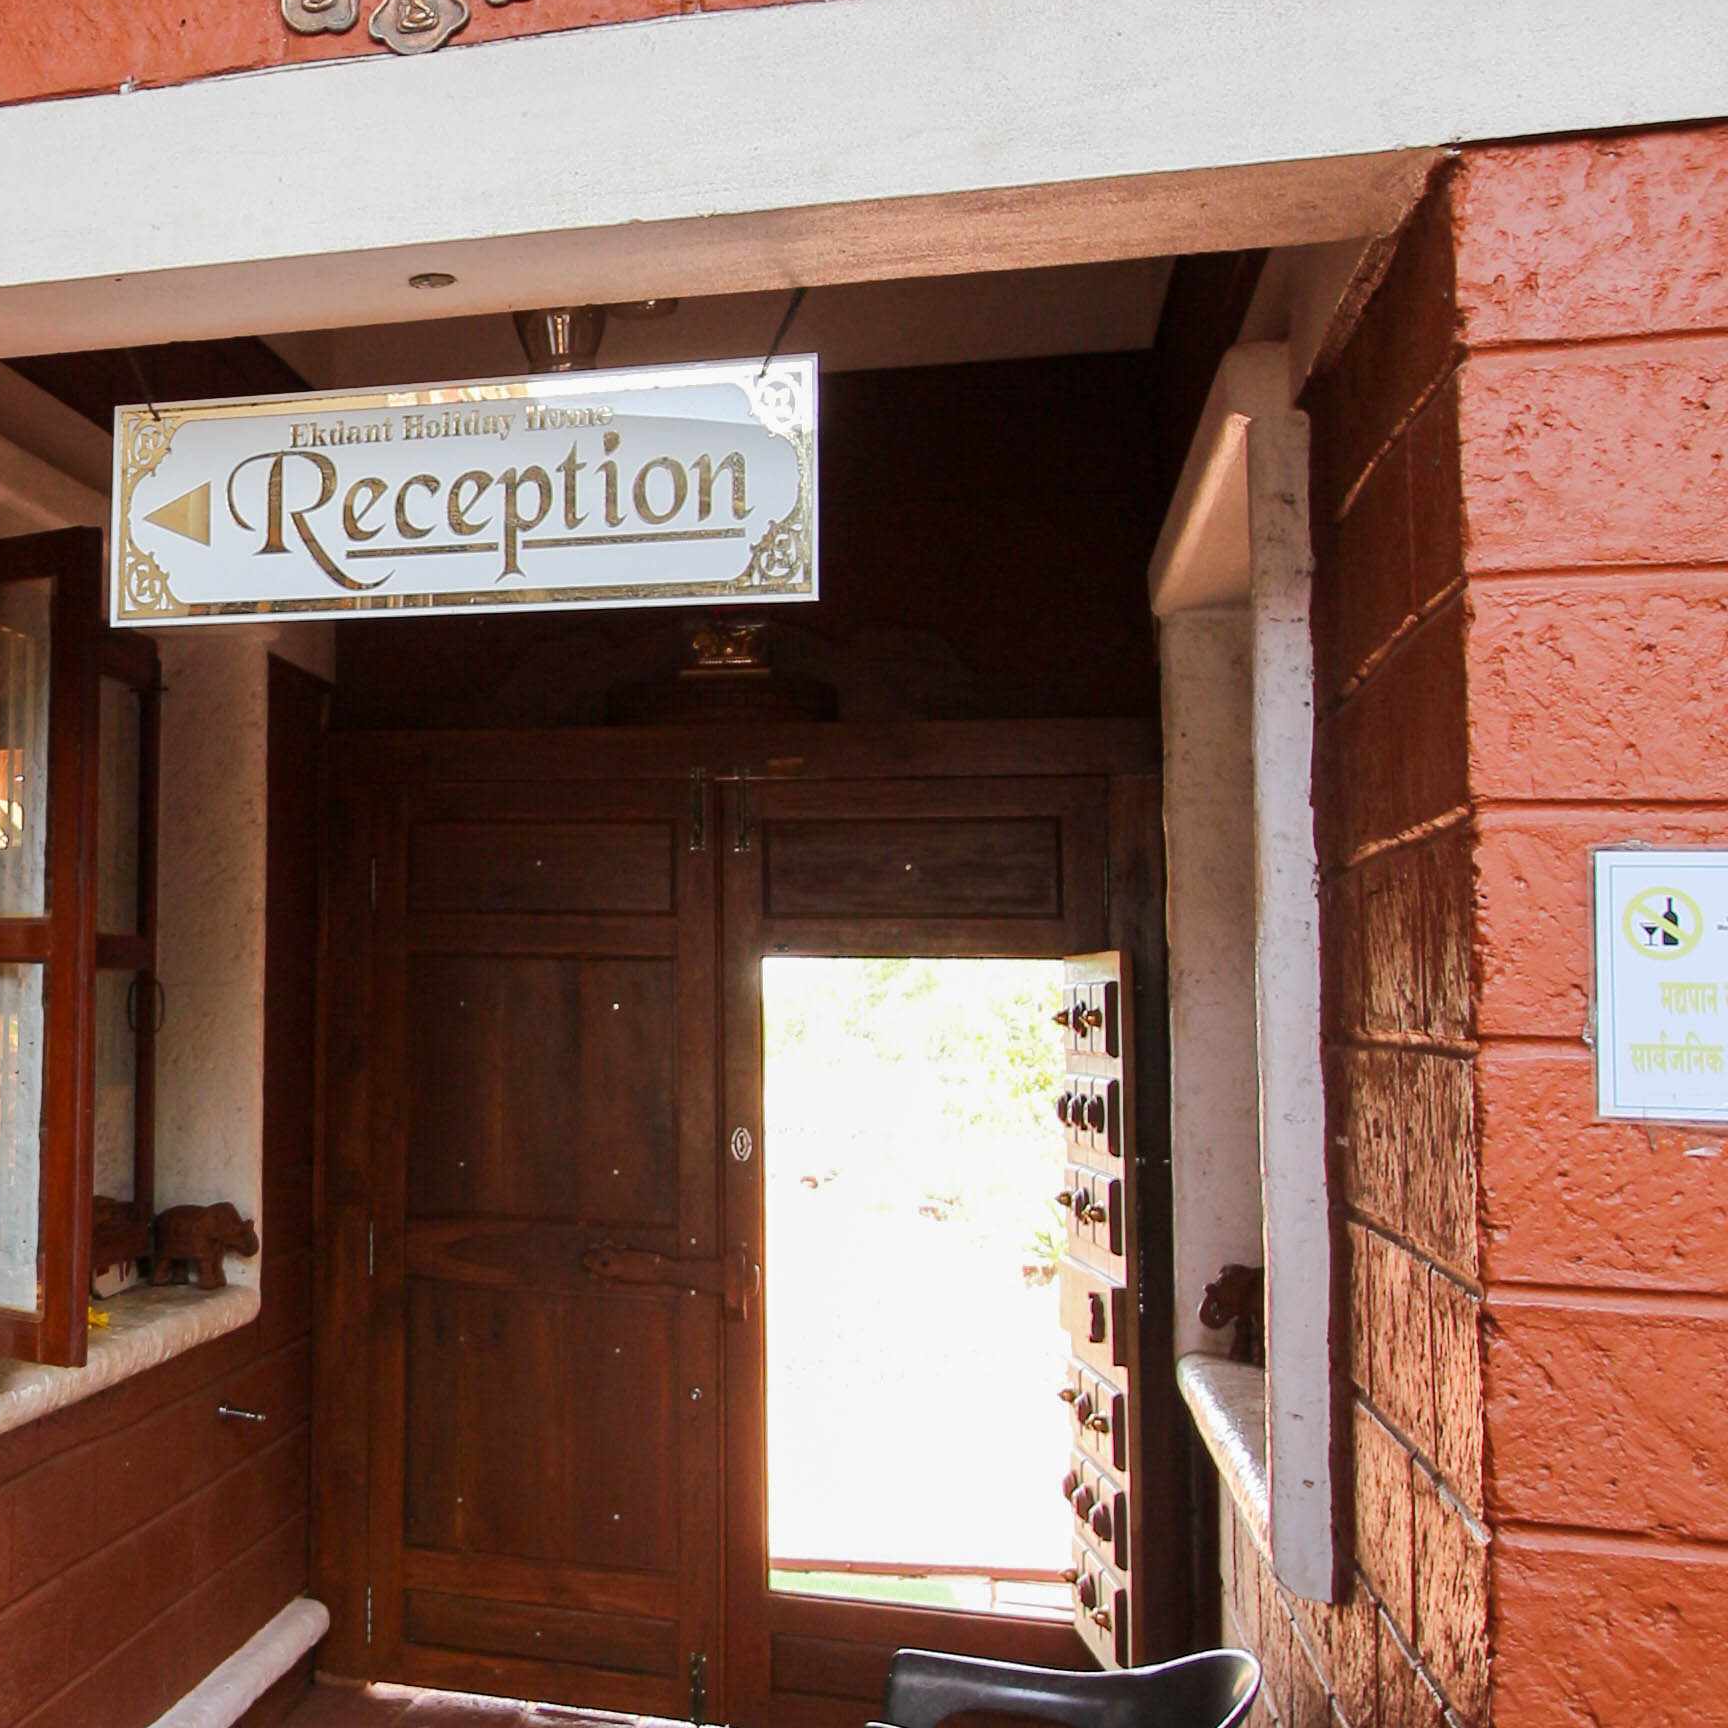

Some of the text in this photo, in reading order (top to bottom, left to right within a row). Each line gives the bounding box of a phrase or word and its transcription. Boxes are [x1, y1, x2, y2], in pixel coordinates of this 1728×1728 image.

[289, 404, 614, 449] Ekdant Holiday Home
[226, 430, 755, 591] Reception
[1630, 1028, 1724, 1074] सार्वजनिक
